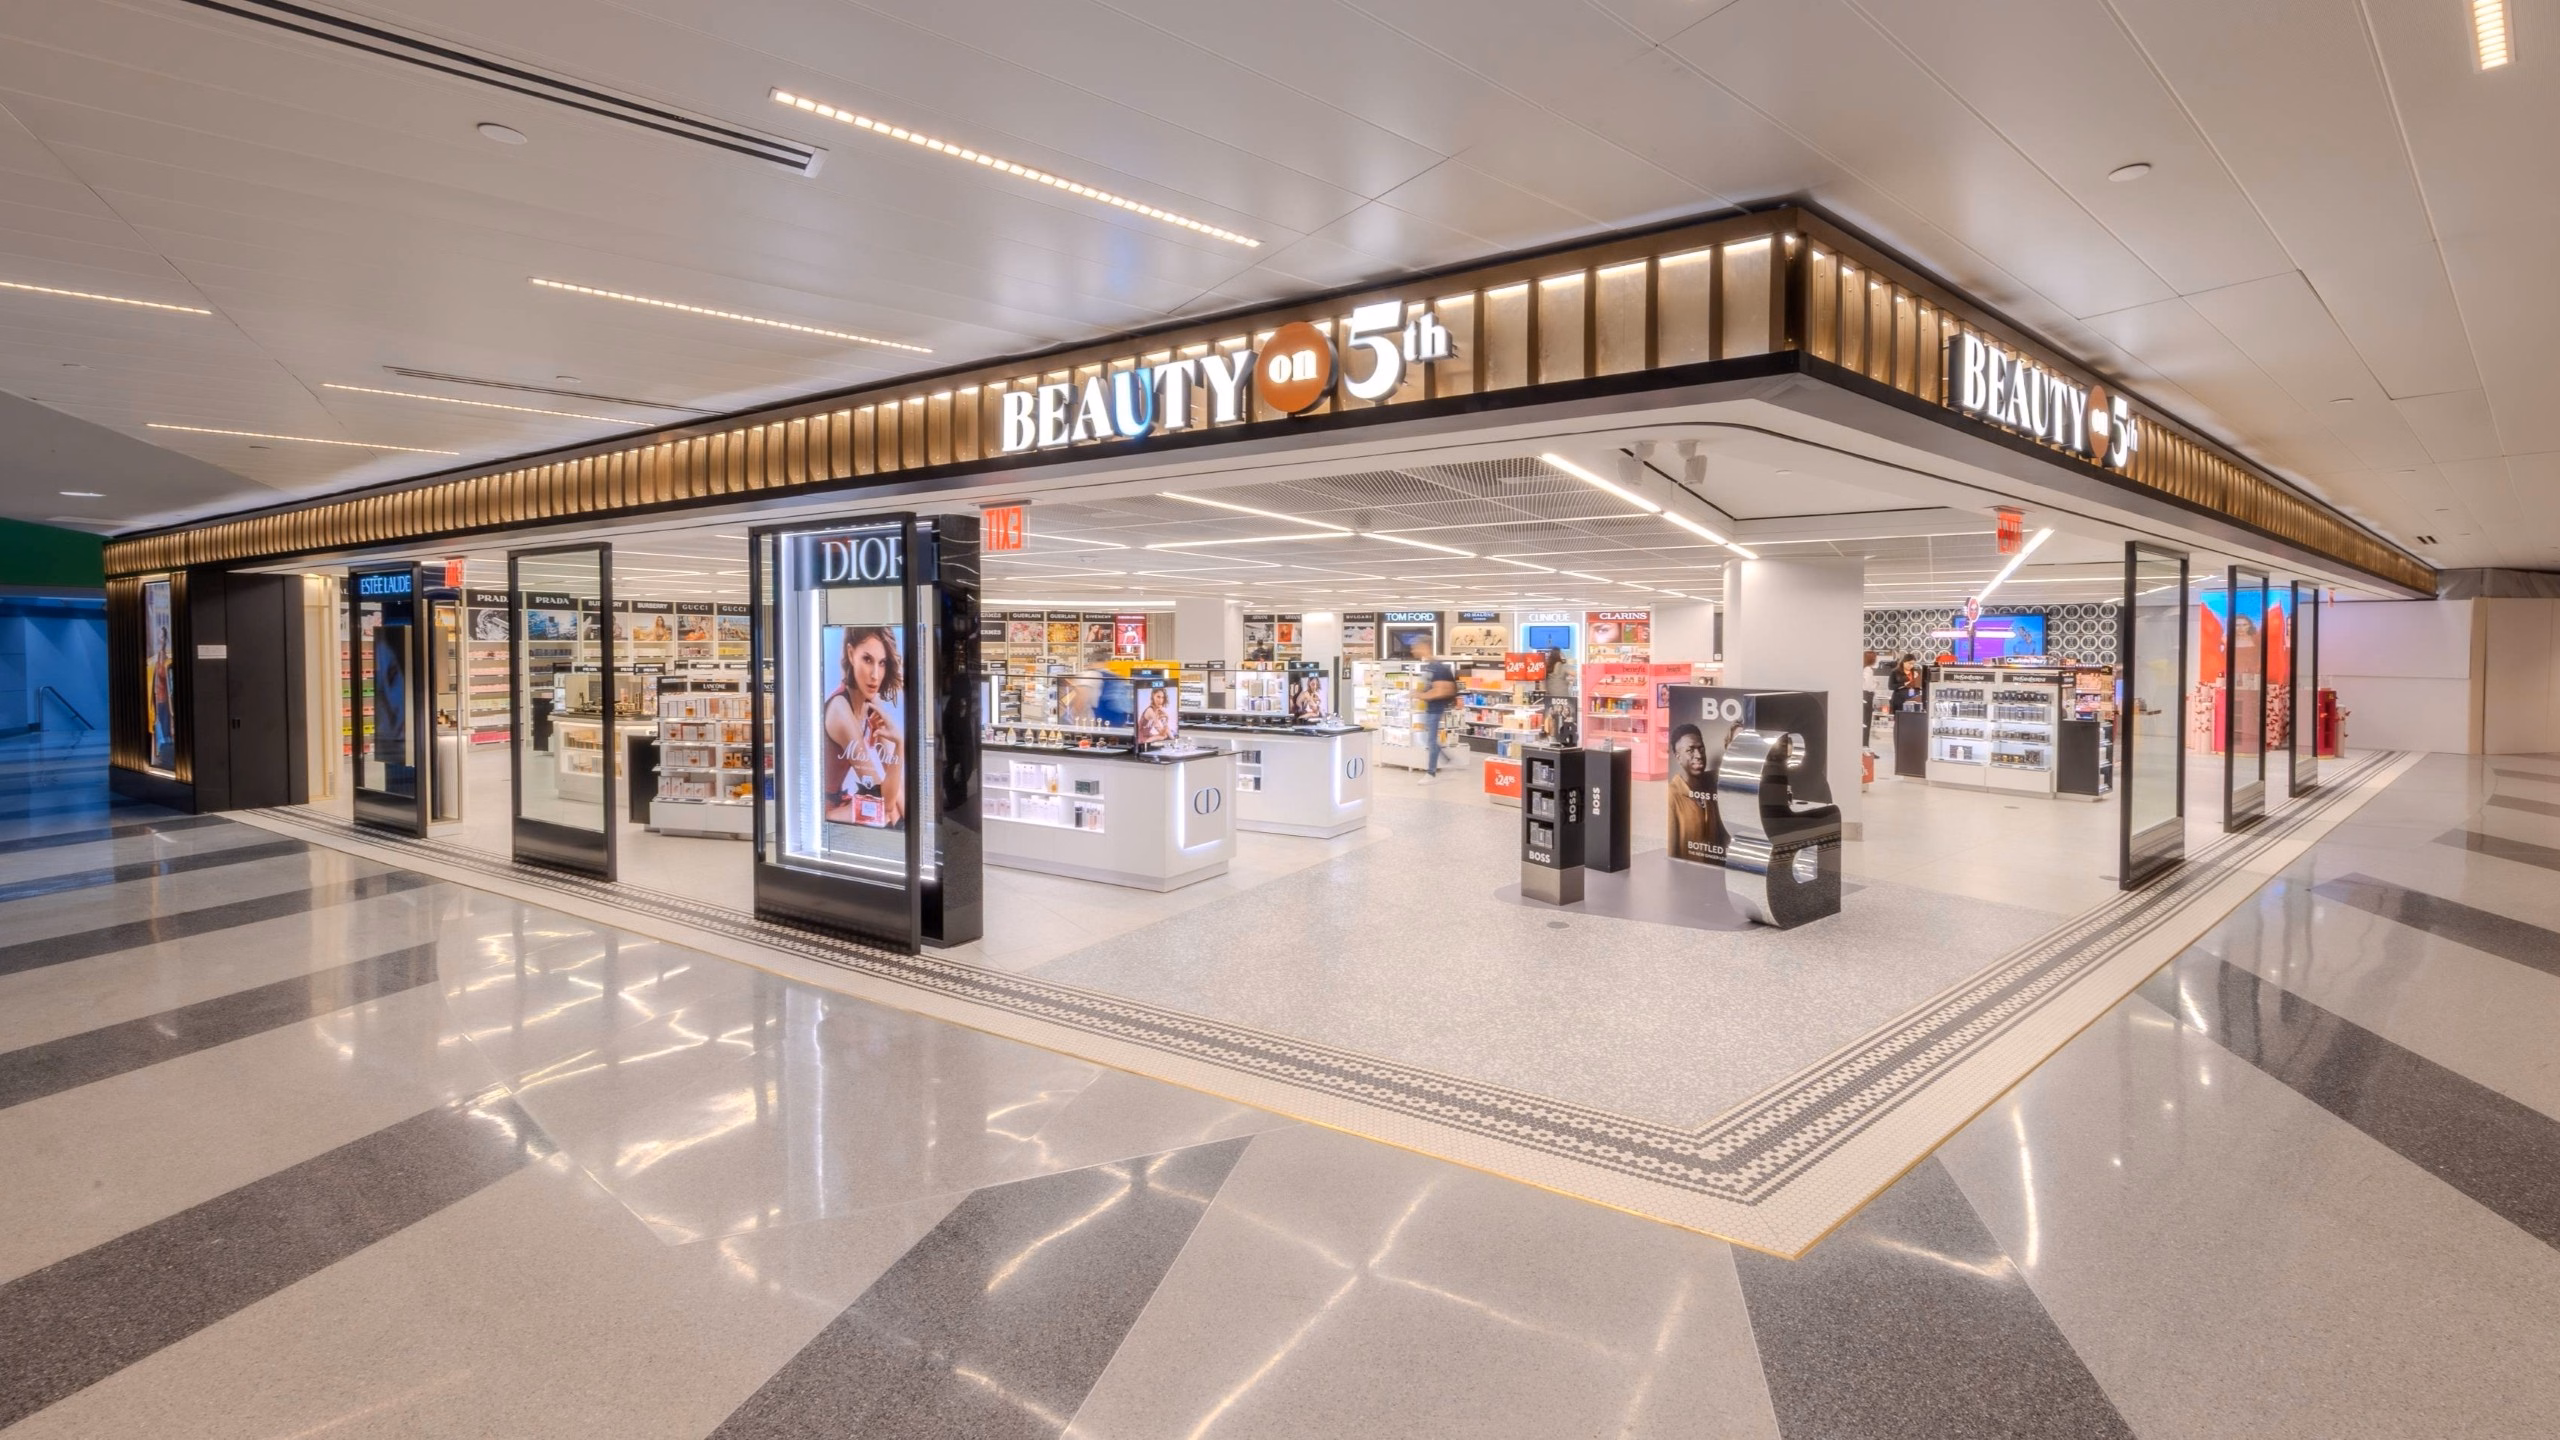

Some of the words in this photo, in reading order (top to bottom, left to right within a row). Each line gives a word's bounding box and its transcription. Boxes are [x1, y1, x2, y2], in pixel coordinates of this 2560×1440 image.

[1002, 350, 1258, 452] BEAUTY
[1268, 348, 1318, 384] on
[1344, 300, 1453, 400] 5th
[1963, 332, 2087, 450] BEAUTY
[2112, 395, 2138, 467] 5th
[361, 575, 383, 594] ESTÉE
[384, 575, 411, 593] LAUDE
[477, 594, 509, 603] PRAD
[535, 596, 570, 605] PRADA
[1385, 612, 1407, 621] TOM
[1408, 612, 1435, 621] FORD
[1528, 613, 1571, 622] CLINIQUE
[1599, 612, 1648, 620] CLARINS
[1622, 665, 1646, 675] benefit
[1551, 697, 1568, 706] BOSS
[1701, 697, 1743, 721] BO
[1592, 786, 1601, 816] BOSS
[1688, 790, 1711, 801] BOSS
[1568, 789, 1577, 822] BOSS
[1687, 841, 1724, 854] BOTTLED
[1528, 850, 1551, 864] BOSS
